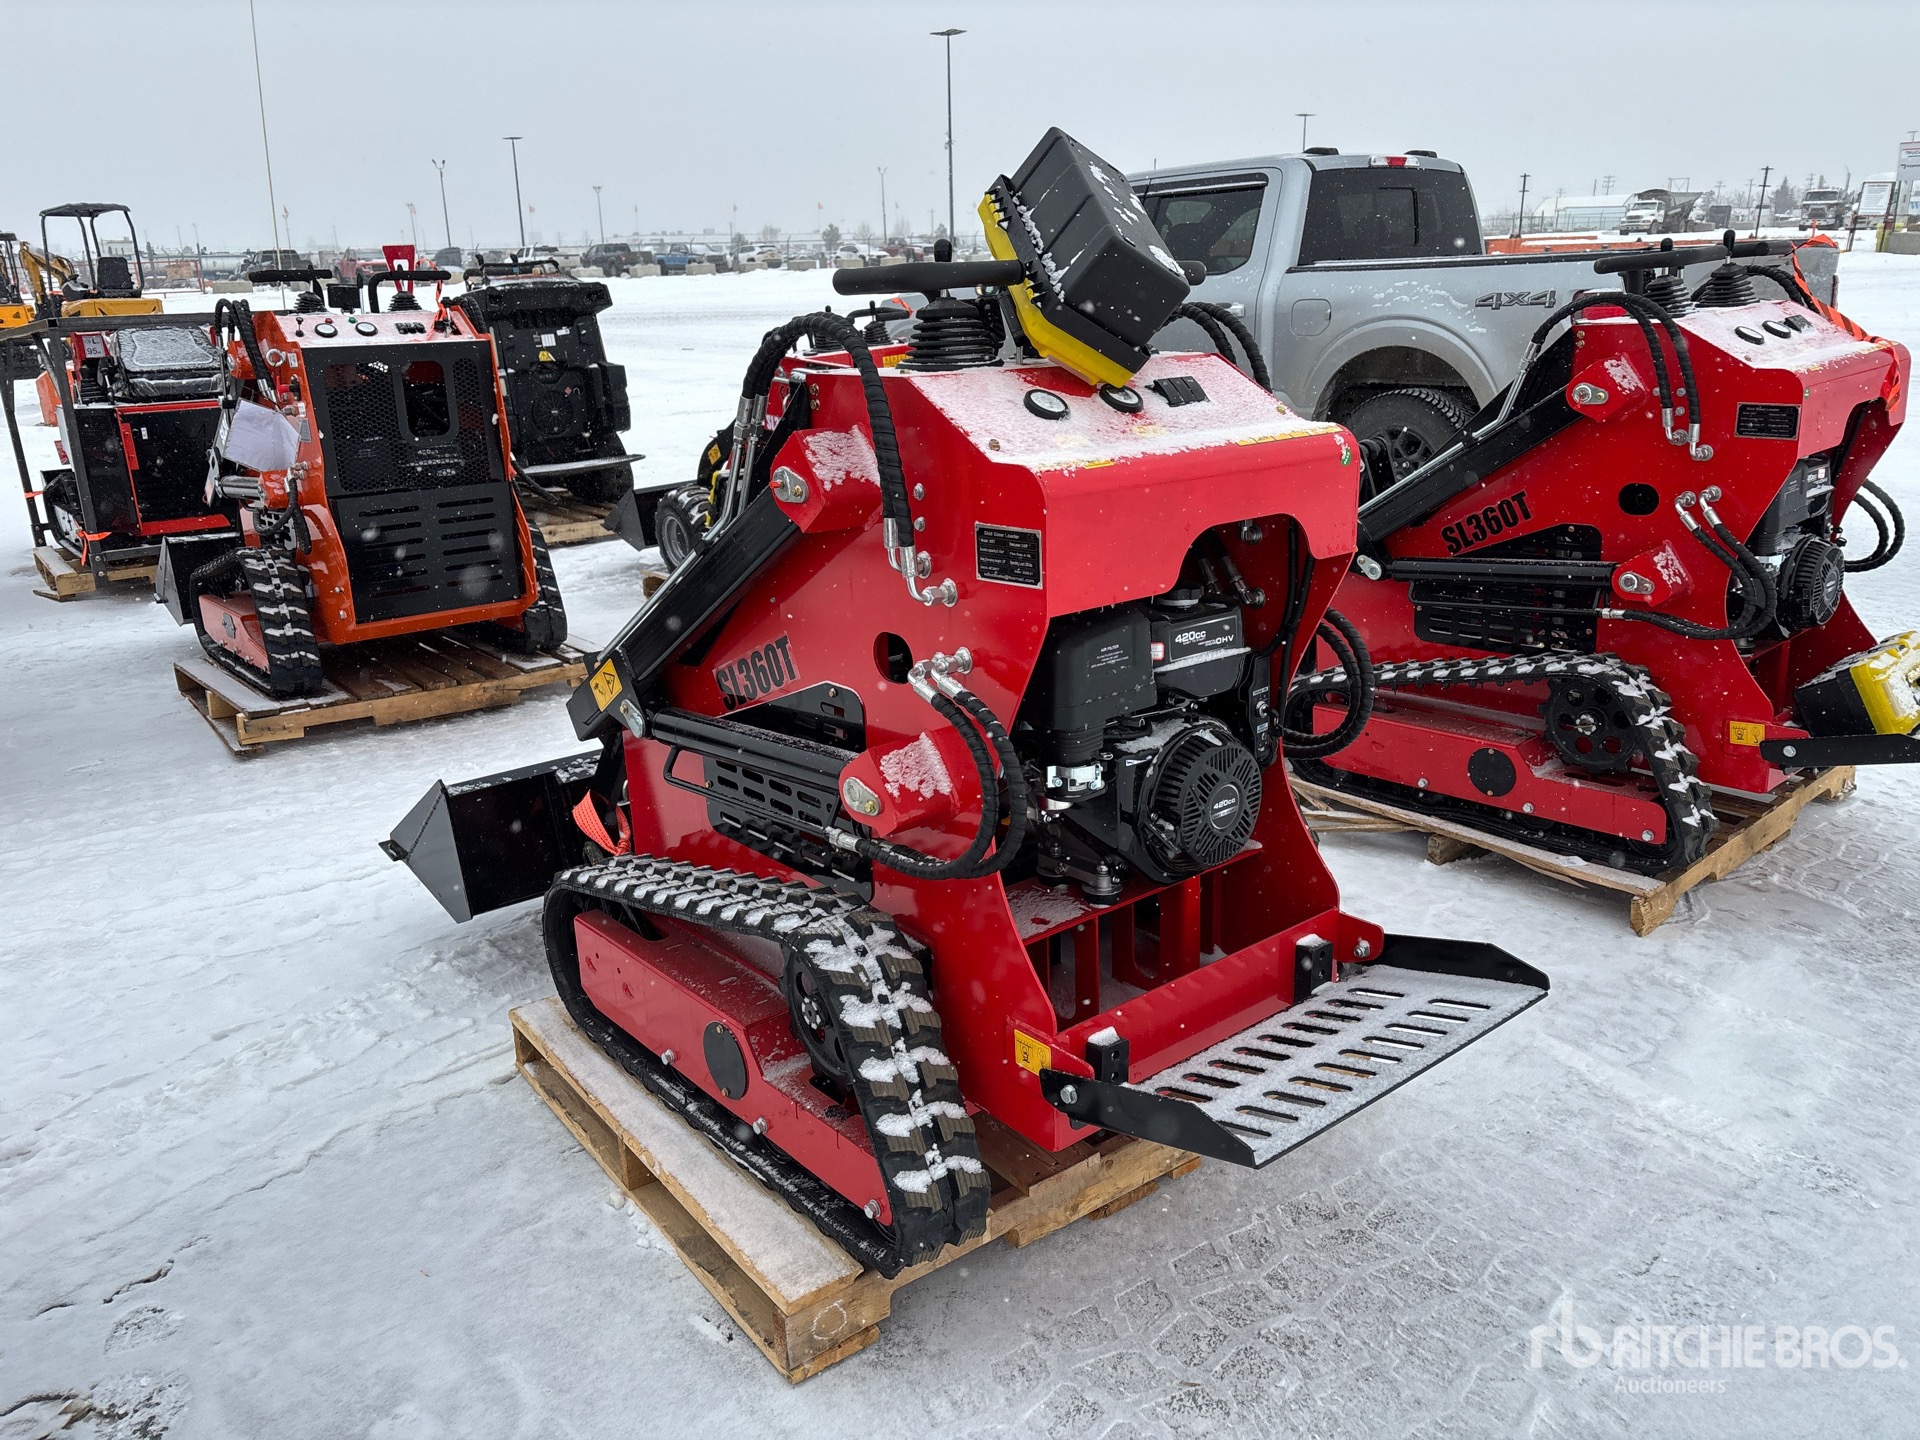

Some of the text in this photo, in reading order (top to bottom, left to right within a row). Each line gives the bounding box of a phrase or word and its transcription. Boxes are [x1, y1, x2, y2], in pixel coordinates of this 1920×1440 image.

[1441, 490, 1532, 553] SL360T
[1175, 630, 1206, 644] 420cc
[1215, 634, 1235, 645] OHV
[716, 636, 796, 711] SL360T
